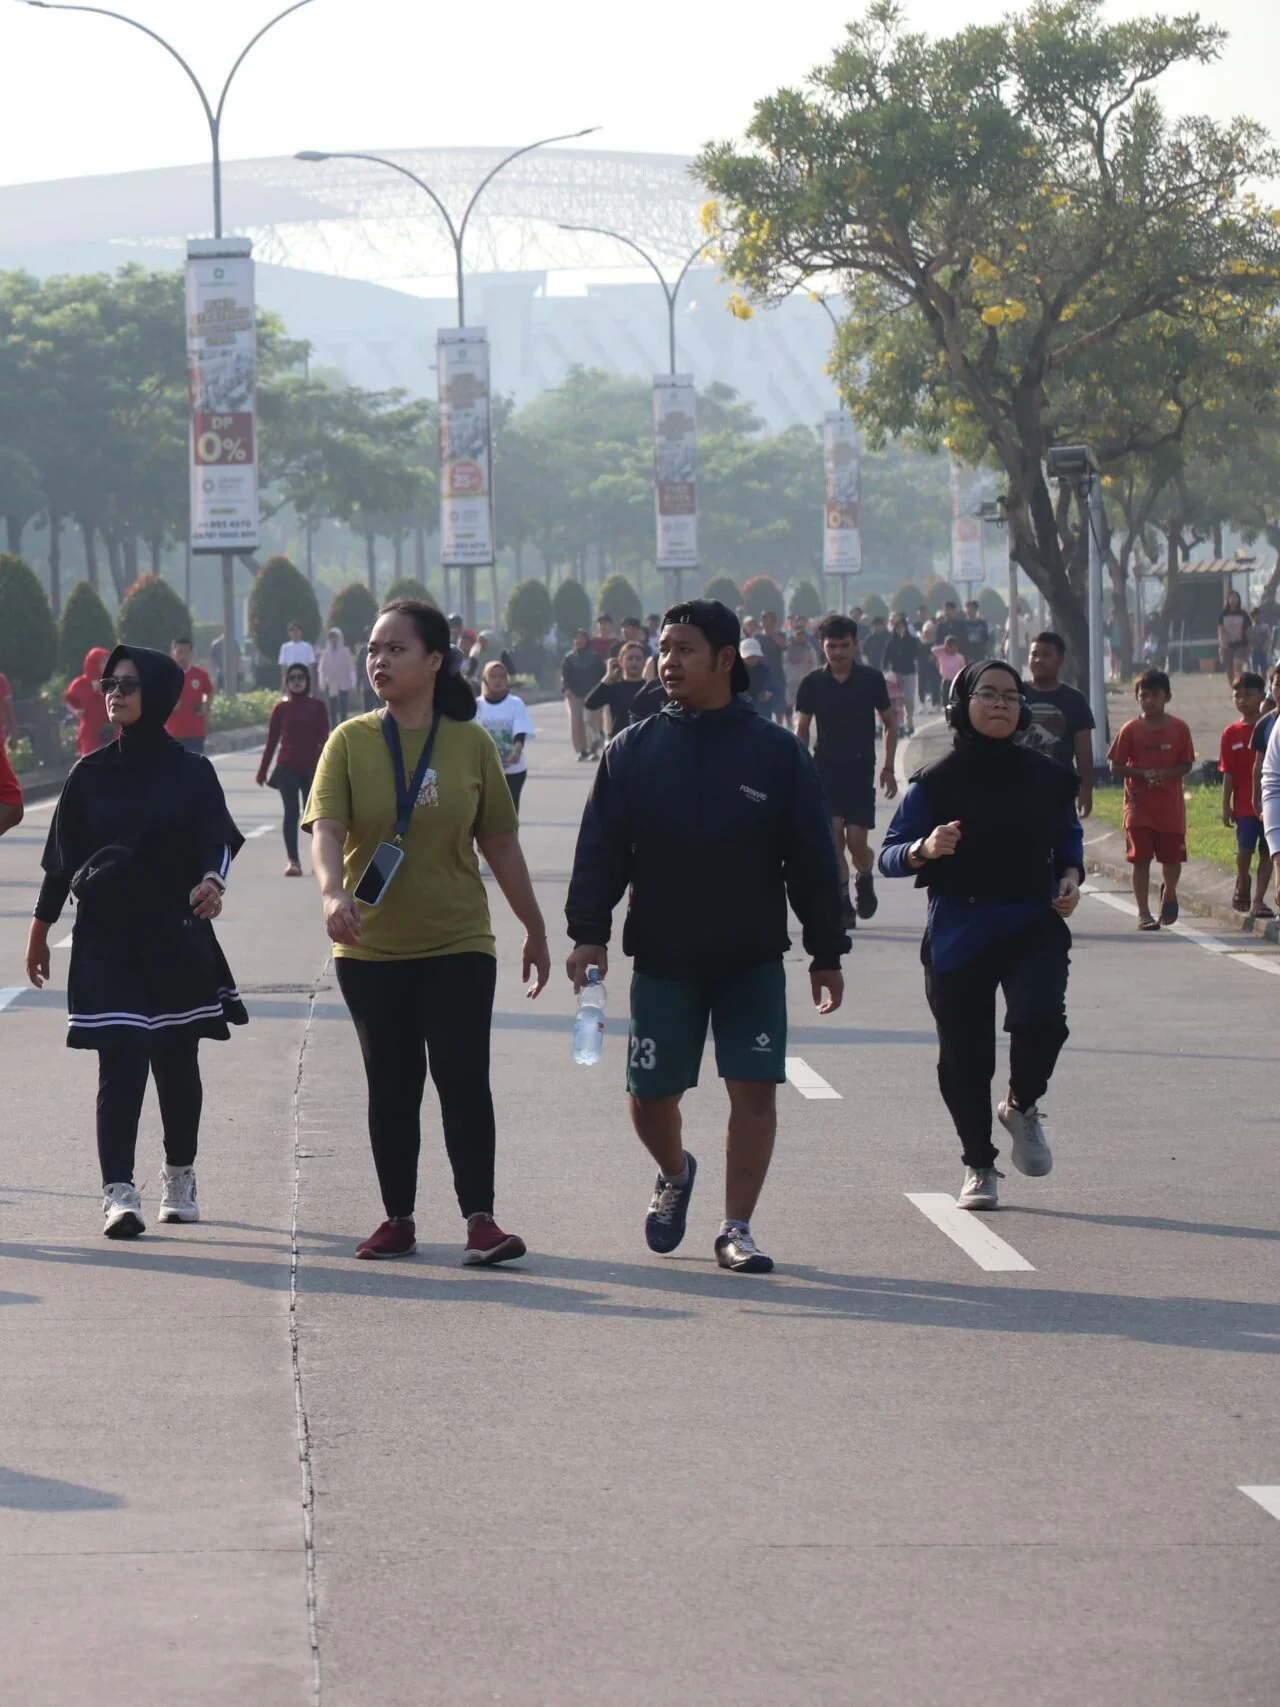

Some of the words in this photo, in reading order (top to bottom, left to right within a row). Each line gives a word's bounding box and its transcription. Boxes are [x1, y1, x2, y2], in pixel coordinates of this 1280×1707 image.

[211, 416, 234, 430] DP
[197, 431, 247, 463] 0%
[630, 1036, 657, 1070] 23
